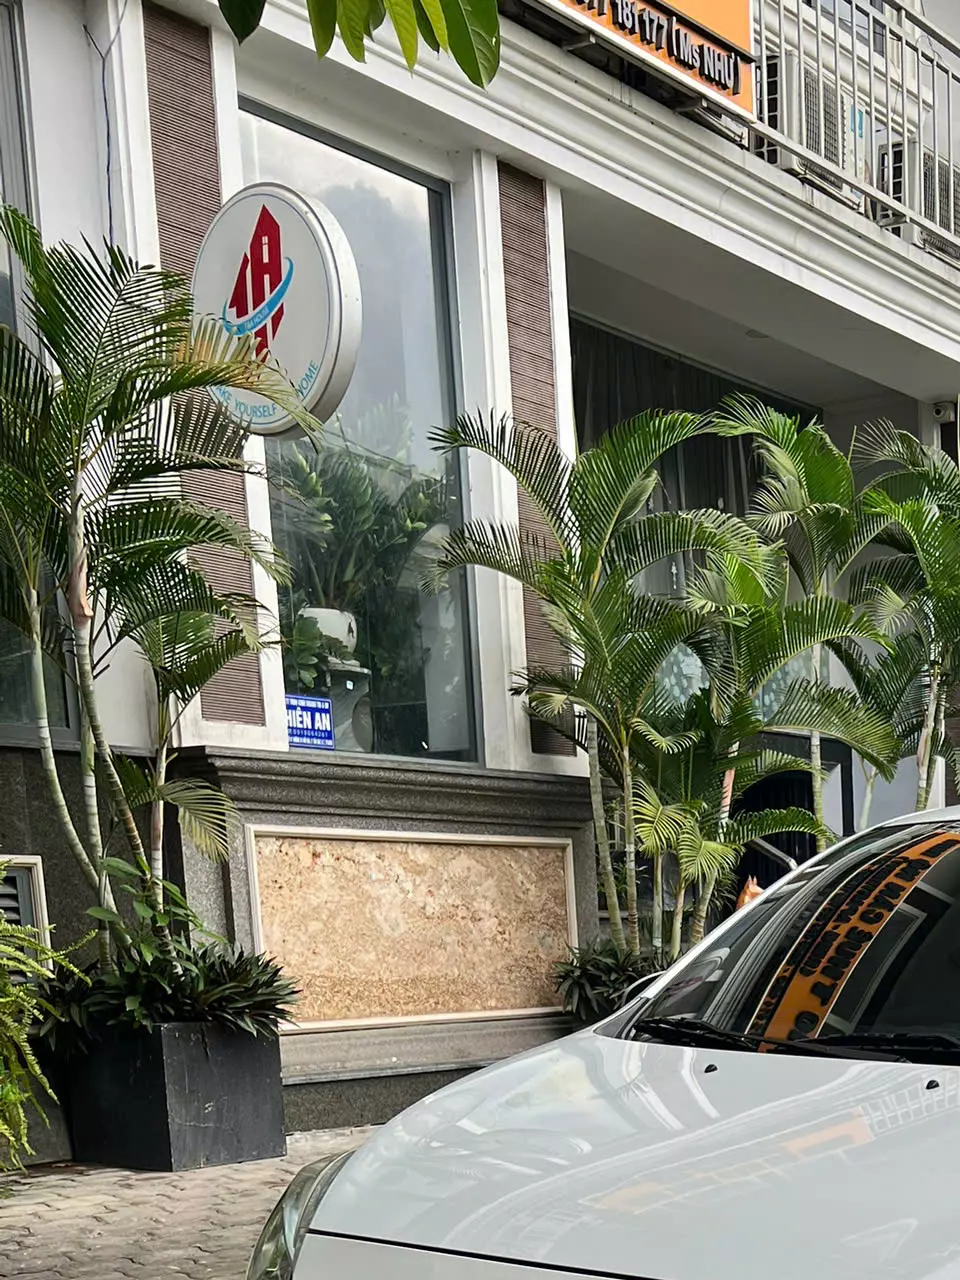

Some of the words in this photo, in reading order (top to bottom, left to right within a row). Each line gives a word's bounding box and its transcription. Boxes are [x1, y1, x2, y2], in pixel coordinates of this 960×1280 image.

[641, 7, 668, 49] 177
[235, 398, 277, 418] YOURSELF
[314, 711, 331, 731] AN
